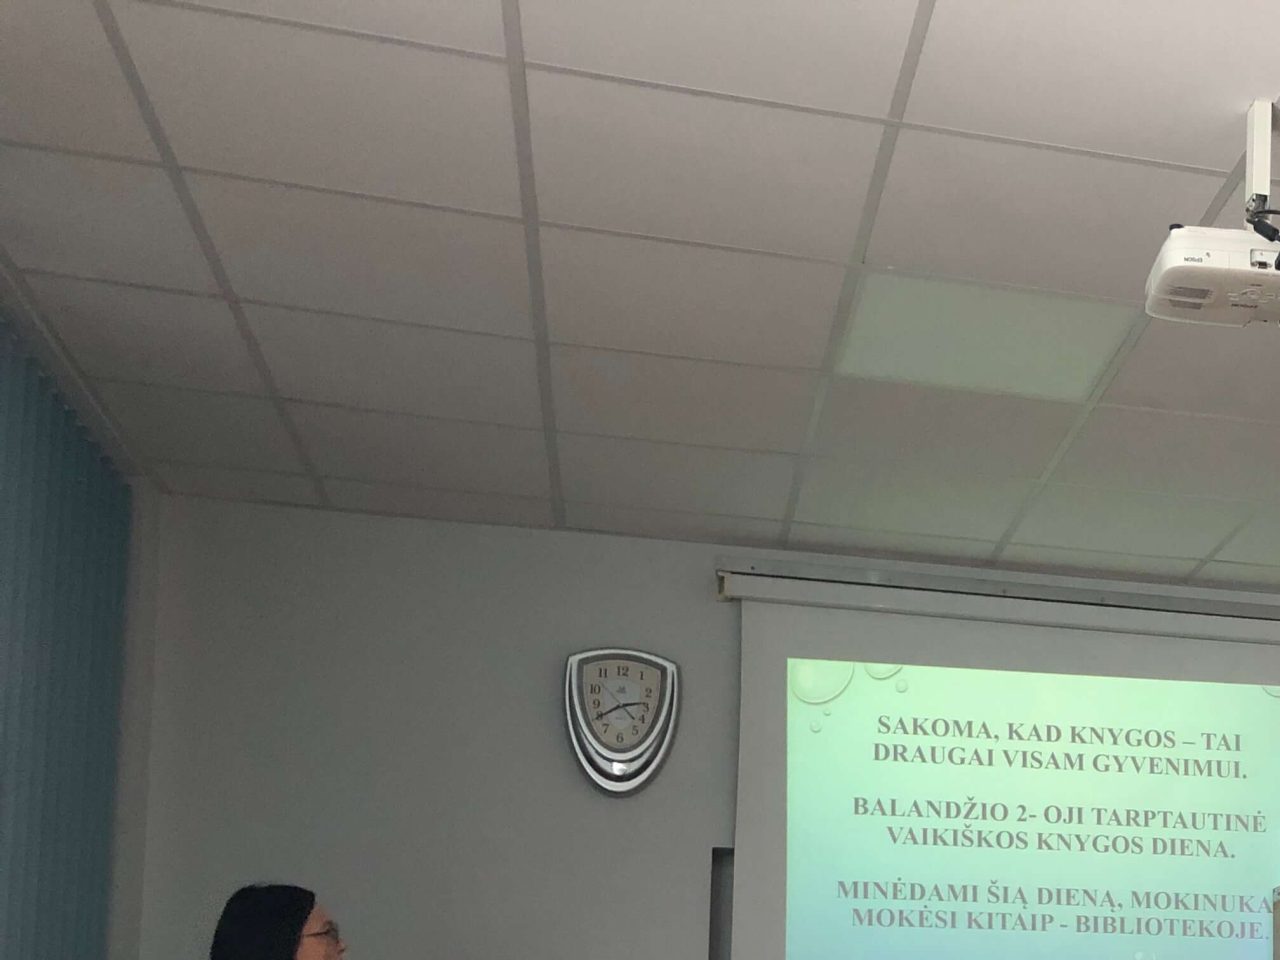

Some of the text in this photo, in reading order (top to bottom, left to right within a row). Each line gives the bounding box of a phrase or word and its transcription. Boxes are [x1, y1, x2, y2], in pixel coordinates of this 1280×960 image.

[599, 667, 607, 678] 11
[617, 665, 629, 677] 12
[640, 671, 643, 680] 1
[590, 684, 601, 695] 10
[645, 688, 652, 698] 2
[593, 700, 600, 709] 9
[639, 714, 645, 724] 4
[602, 723, 609, 733] 7
[632, 725, 638, 736] 5
[877, 715, 999, 742] SAKOMA,
[1007, 722, 1062, 743] KAD
[1070, 726, 1176, 749] KNYGOS
[1201, 732, 1242, 752] TAI
[616, 732, 624, 743] 6
[873, 743, 1247, 779] DRAUGAI VISAM GYVENIMUI.
[853, 796, 1266, 833] BALANDŽIO 2- OJI TARPTAUTINĖ
[887, 823, 1236, 859] VAIKIŠKOS KNYGOS DIENA.
[837, 877, 979, 903] MINĖDAMI
[987, 880, 1028, 910] ŠIĄ
[1037, 886, 1123, 912] DIENĄ,
[852, 904, 957, 929] MOKĖSI
[967, 911, 1055, 932] KITAIP
[1075, 914, 1270, 940] BIBLIOTEKOJE.
